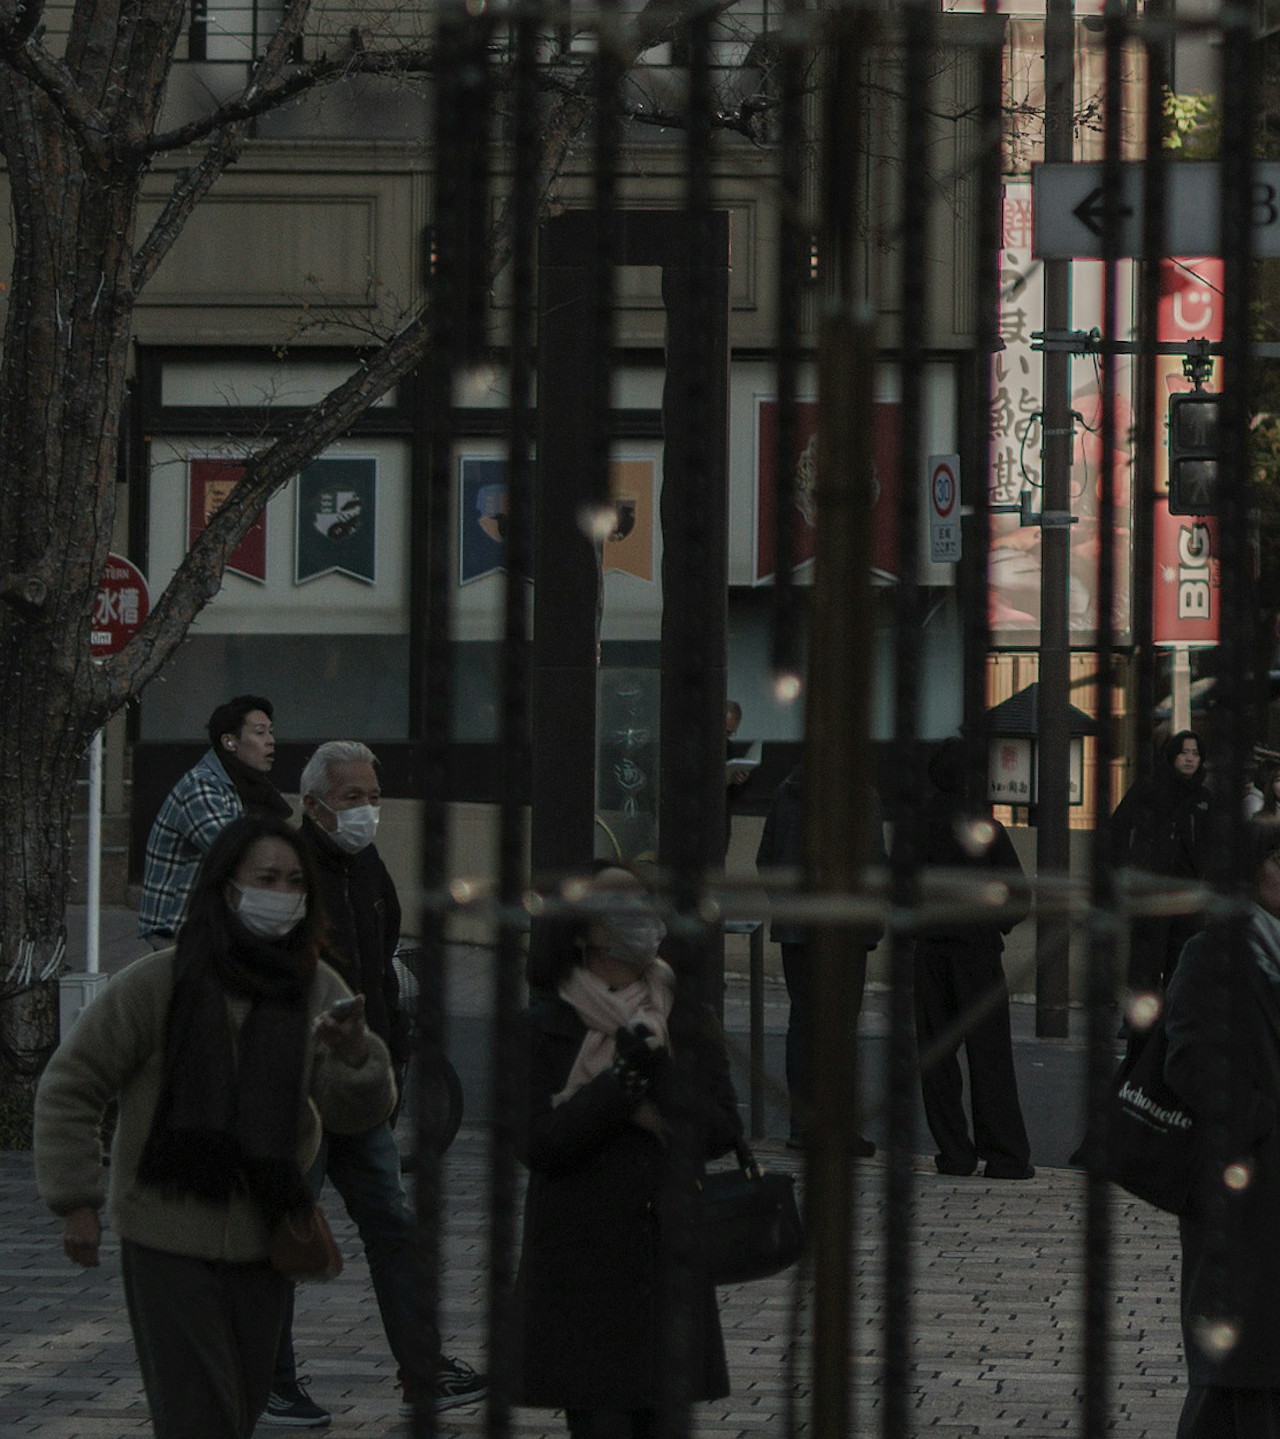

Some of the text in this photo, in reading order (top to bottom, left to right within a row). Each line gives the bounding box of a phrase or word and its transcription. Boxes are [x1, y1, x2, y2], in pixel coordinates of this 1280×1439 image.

[937, 479, 951, 503] 30
[102, 566, 130, 580] TERN
[1176, 524, 1212, 620] BIG
[92, 586, 140, 626] 水槽
